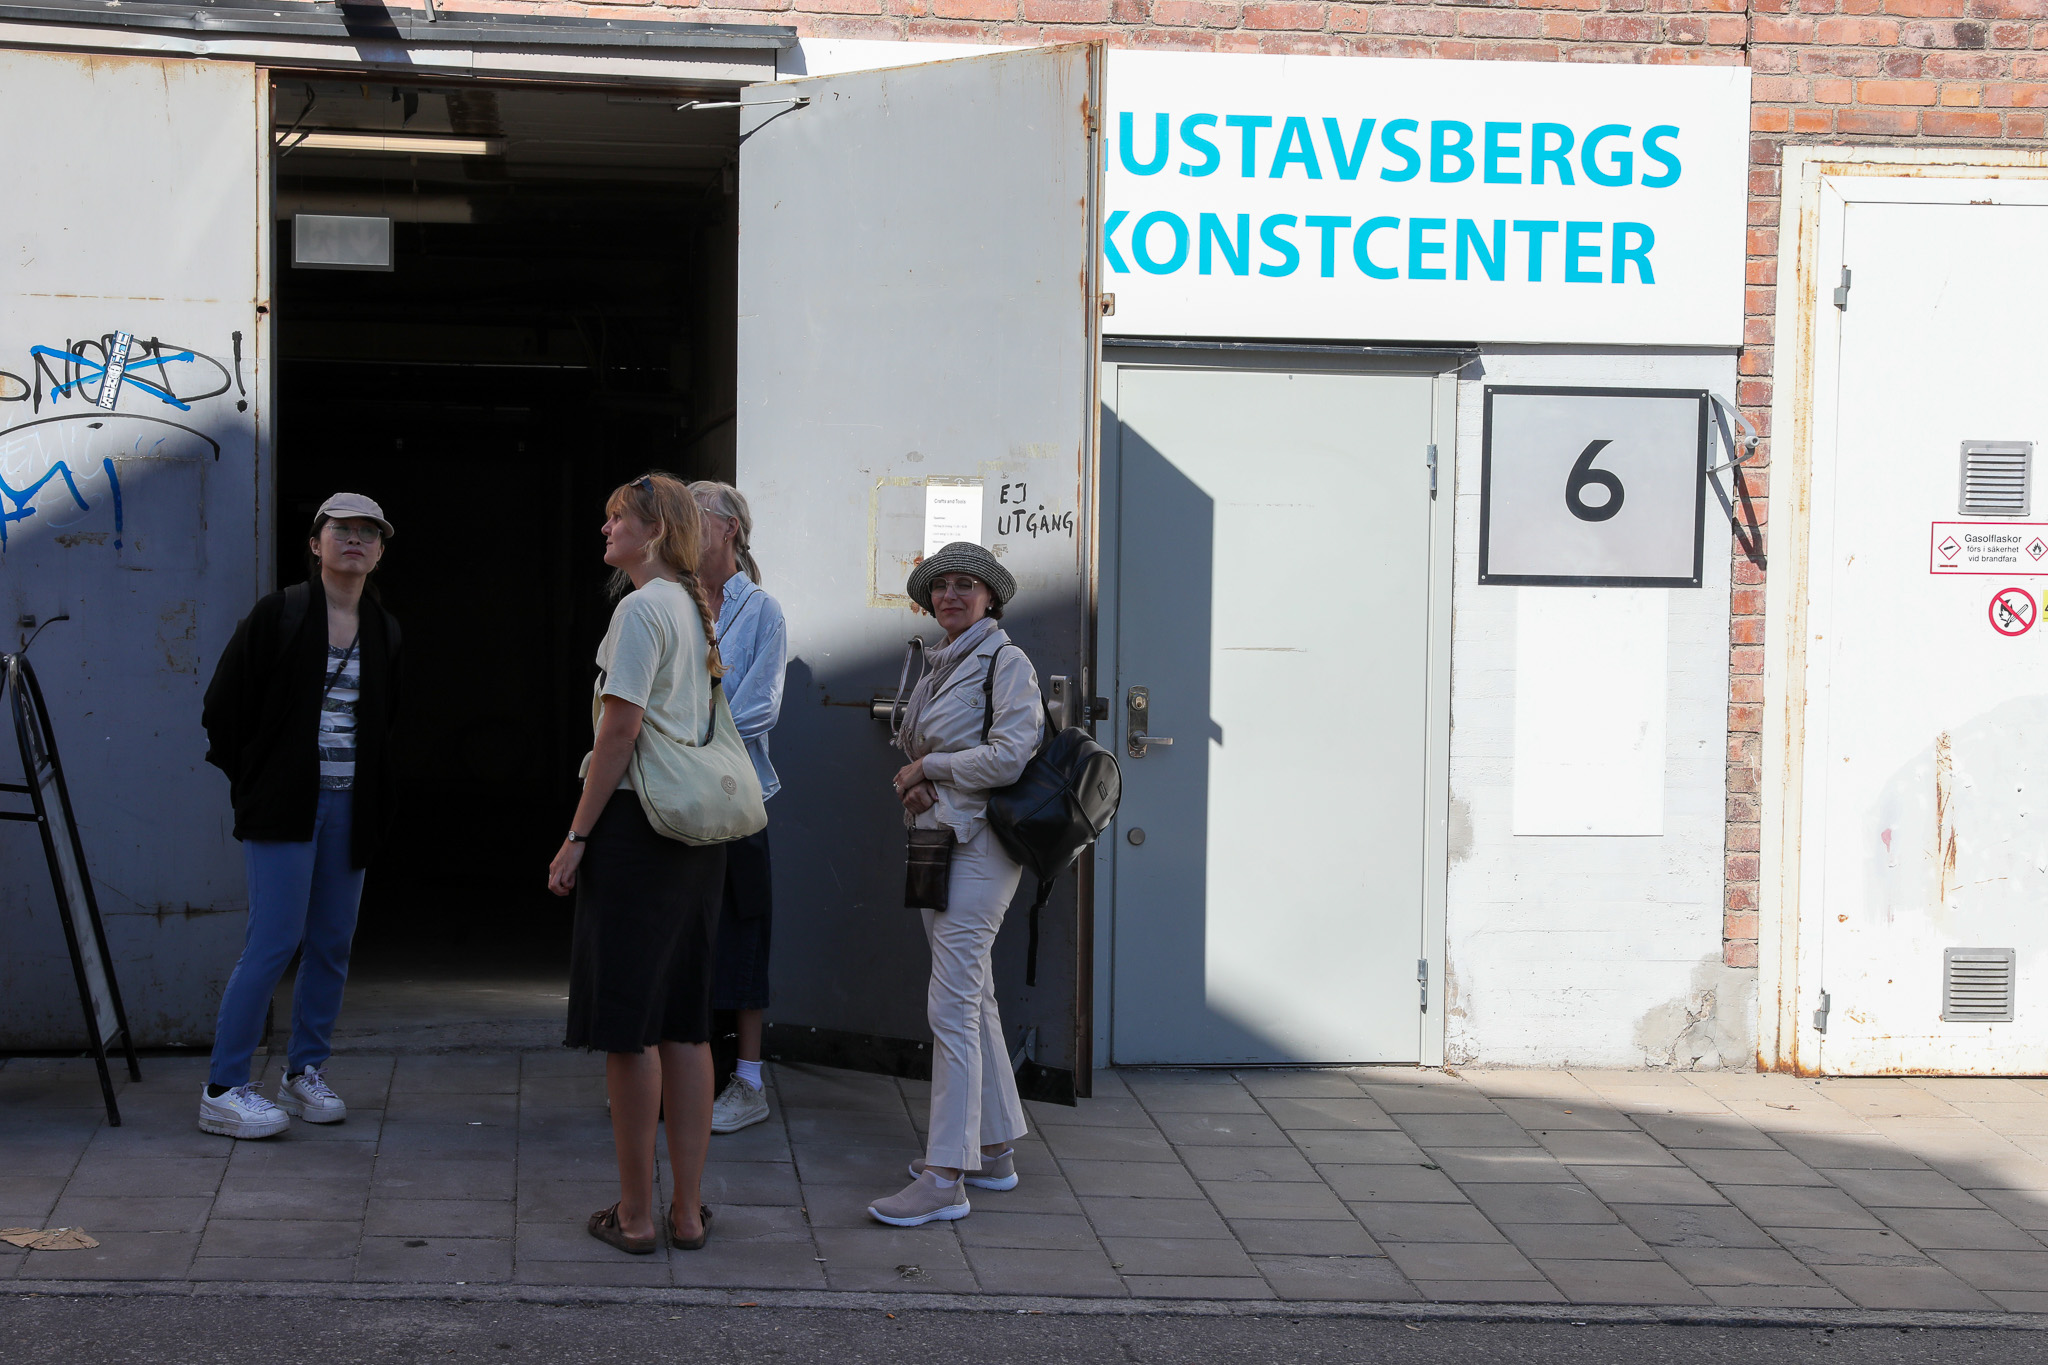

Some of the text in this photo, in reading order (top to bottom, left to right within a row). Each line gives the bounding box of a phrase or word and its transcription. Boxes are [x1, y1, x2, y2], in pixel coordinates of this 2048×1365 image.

[1104, 111, 1683, 189] USTAVSBERGS
[1565, 439, 1625, 523] 6
[1000, 482, 1027, 505] EJ
[1964, 533, 2023, 543] Gasolflaskor
[1967, 545, 1981, 553] förs
[1987, 545, 2019, 553] säkerhet
[1981, 555, 2017, 563] brandfara
